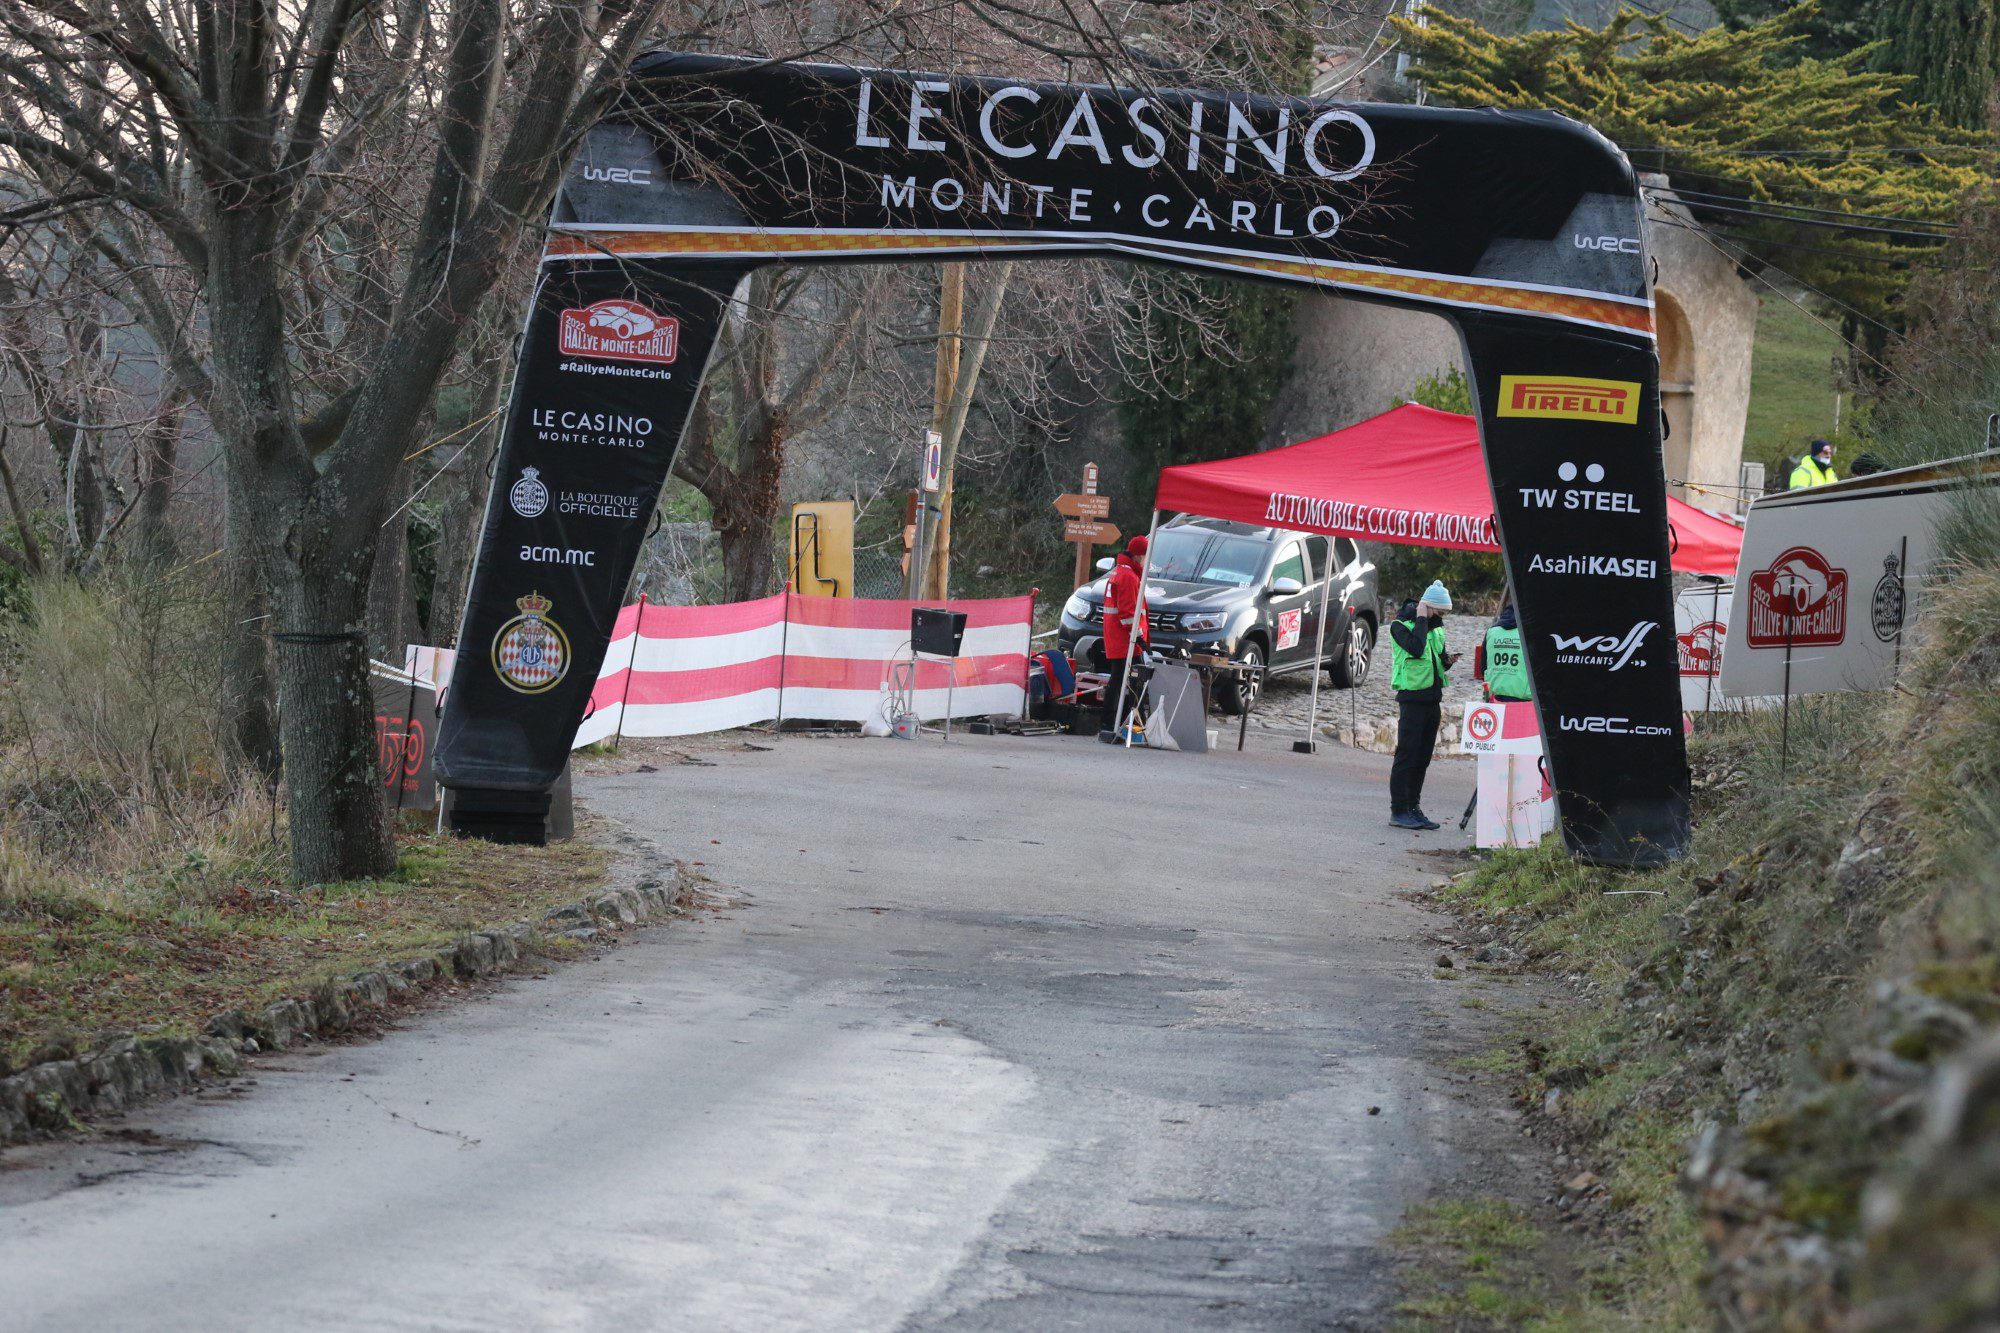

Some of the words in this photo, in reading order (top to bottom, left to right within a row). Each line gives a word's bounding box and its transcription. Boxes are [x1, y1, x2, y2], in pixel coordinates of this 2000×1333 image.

[855, 76, 950, 151] LE
[979, 86, 1376, 182] CASINO
[584, 165, 651, 185] WRC
[1574, 234, 1640, 254] WRC
[566, 315, 586, 332] 2022
[653, 325, 673, 338] 2022
[564, 325, 598, 351] RALLYE
[559, 362, 672, 380] #RallyeMonteCarlo
[1511, 383, 1628, 415] PIRELLI
[533, 409, 556, 428] LE
[561, 411, 653, 435] CASINO
[560, 491, 575, 502] LA
[577, 492, 639, 506] BOUTIQUE
[1519, 488, 1558, 508] TW
[1563, 489, 1641, 514] STEEL
[559, 502, 638, 519] OFFICIELLE
[1265, 492, 1368, 532] AUTOMOBILE
[1368, 507, 1410, 537] CLUB
[1410, 511, 1434, 540] DE
[519, 545, 596, 567] acm.mc
[1528, 554, 1657, 579] AsahiKASEI
[1753, 582, 1771, 608] 2022
[1825, 581, 1844, 605] 2022
[1751, 597, 1780, 637] RALLYE
[1493, 652, 1519, 667] 096
[1556, 654, 1614, 666] LUBRICANTS
[1698, 658, 1721, 672] MOTE
[1464, 741, 1474, 749] NO
[1475, 742, 1496, 751] PUBLIC
